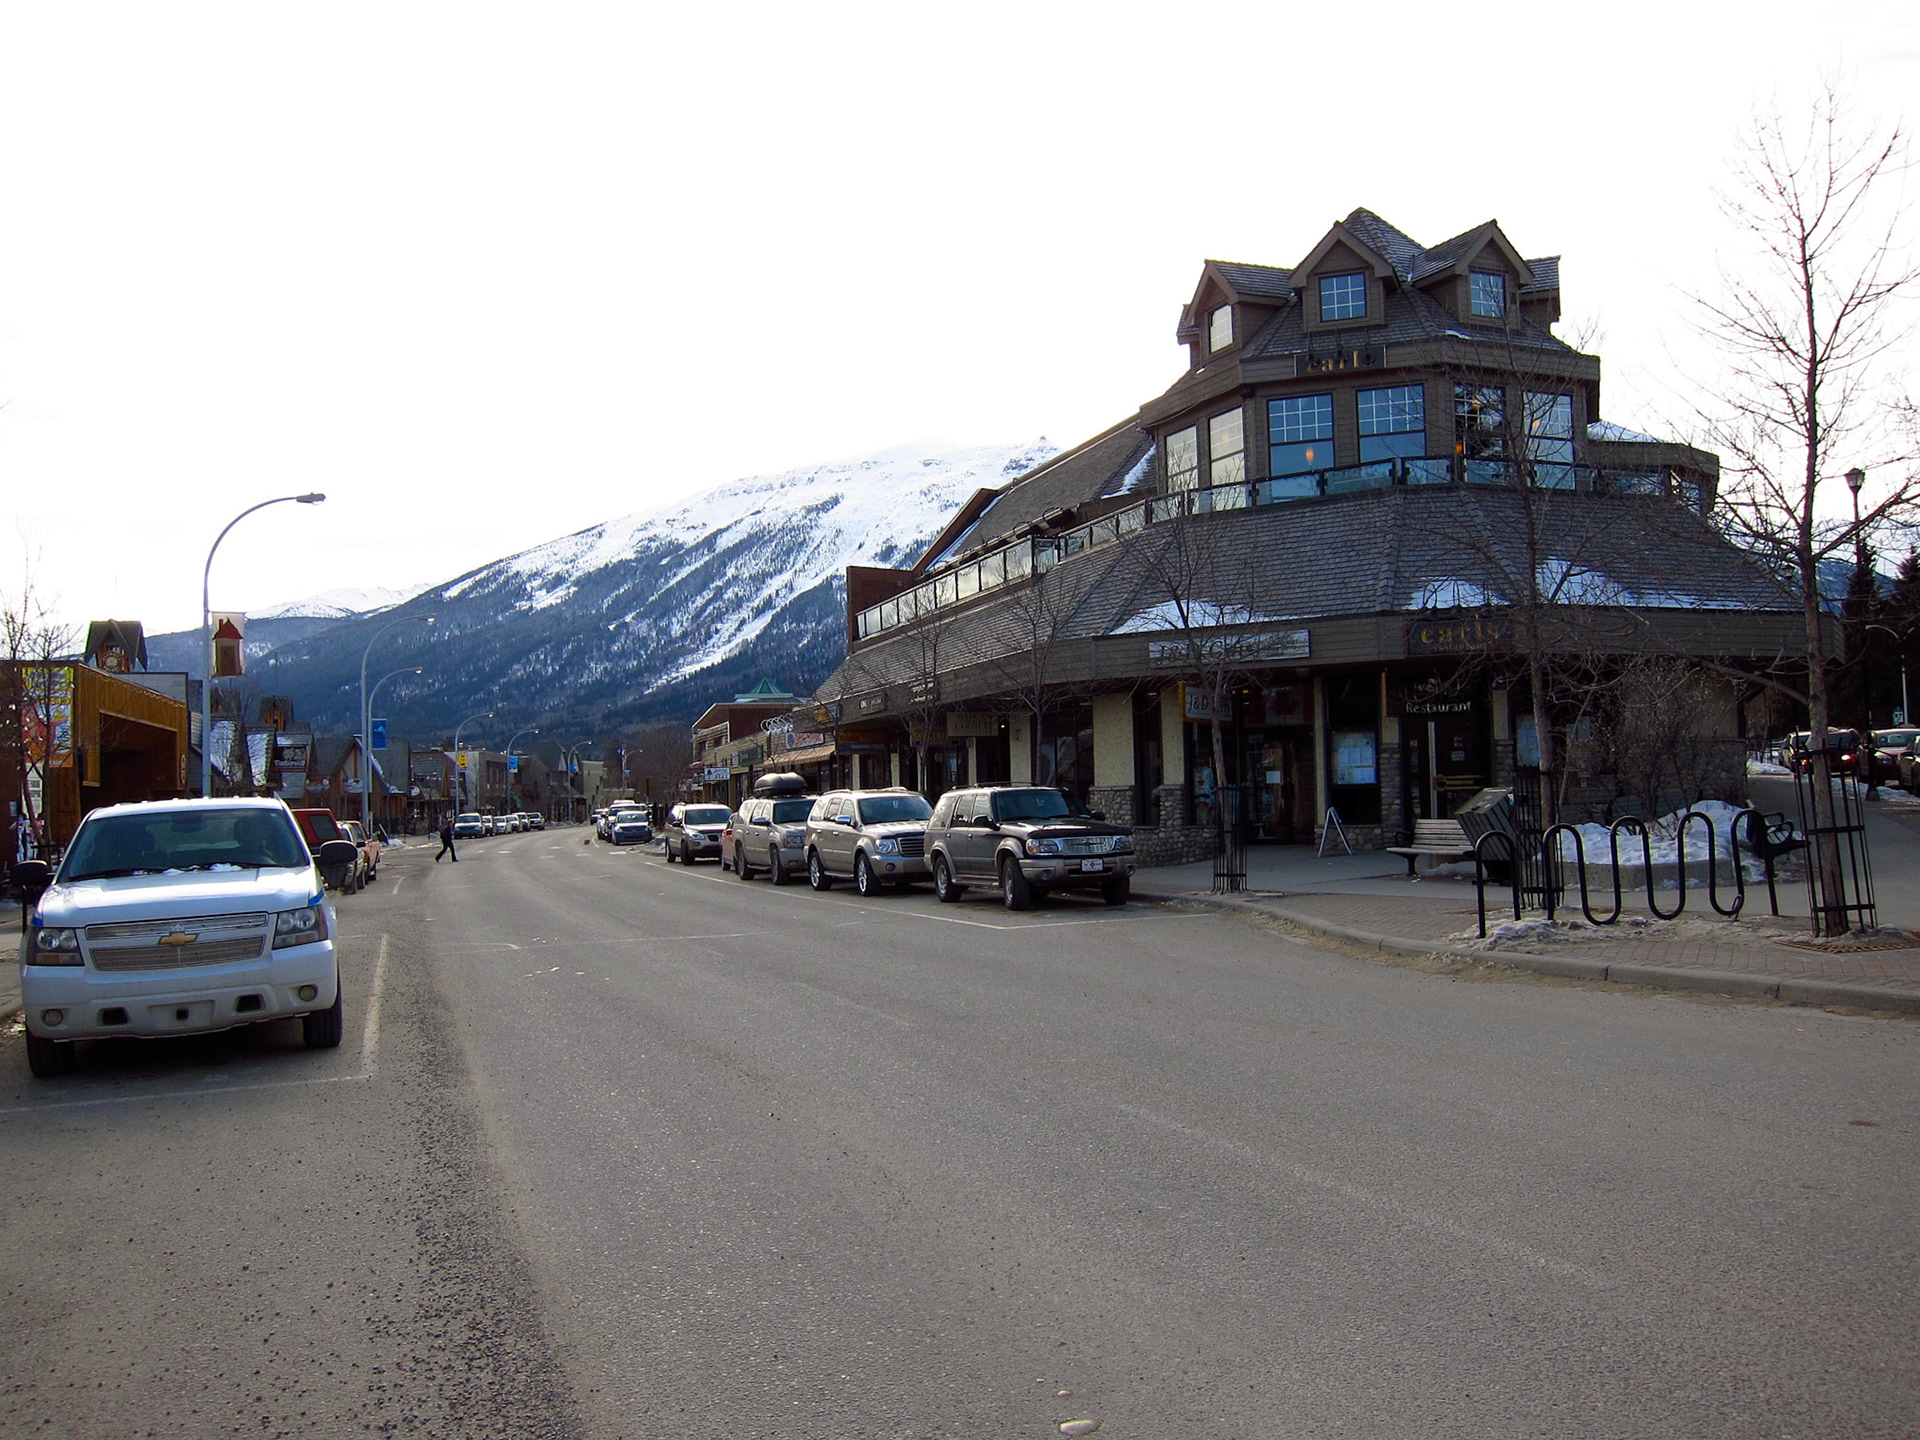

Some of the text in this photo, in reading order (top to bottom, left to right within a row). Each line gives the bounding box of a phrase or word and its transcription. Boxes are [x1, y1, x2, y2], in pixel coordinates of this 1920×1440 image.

[1306, 349, 1375, 374] earl
[1188, 694, 1209, 712] J&D
[1405, 701, 1472, 715] Restaurant
